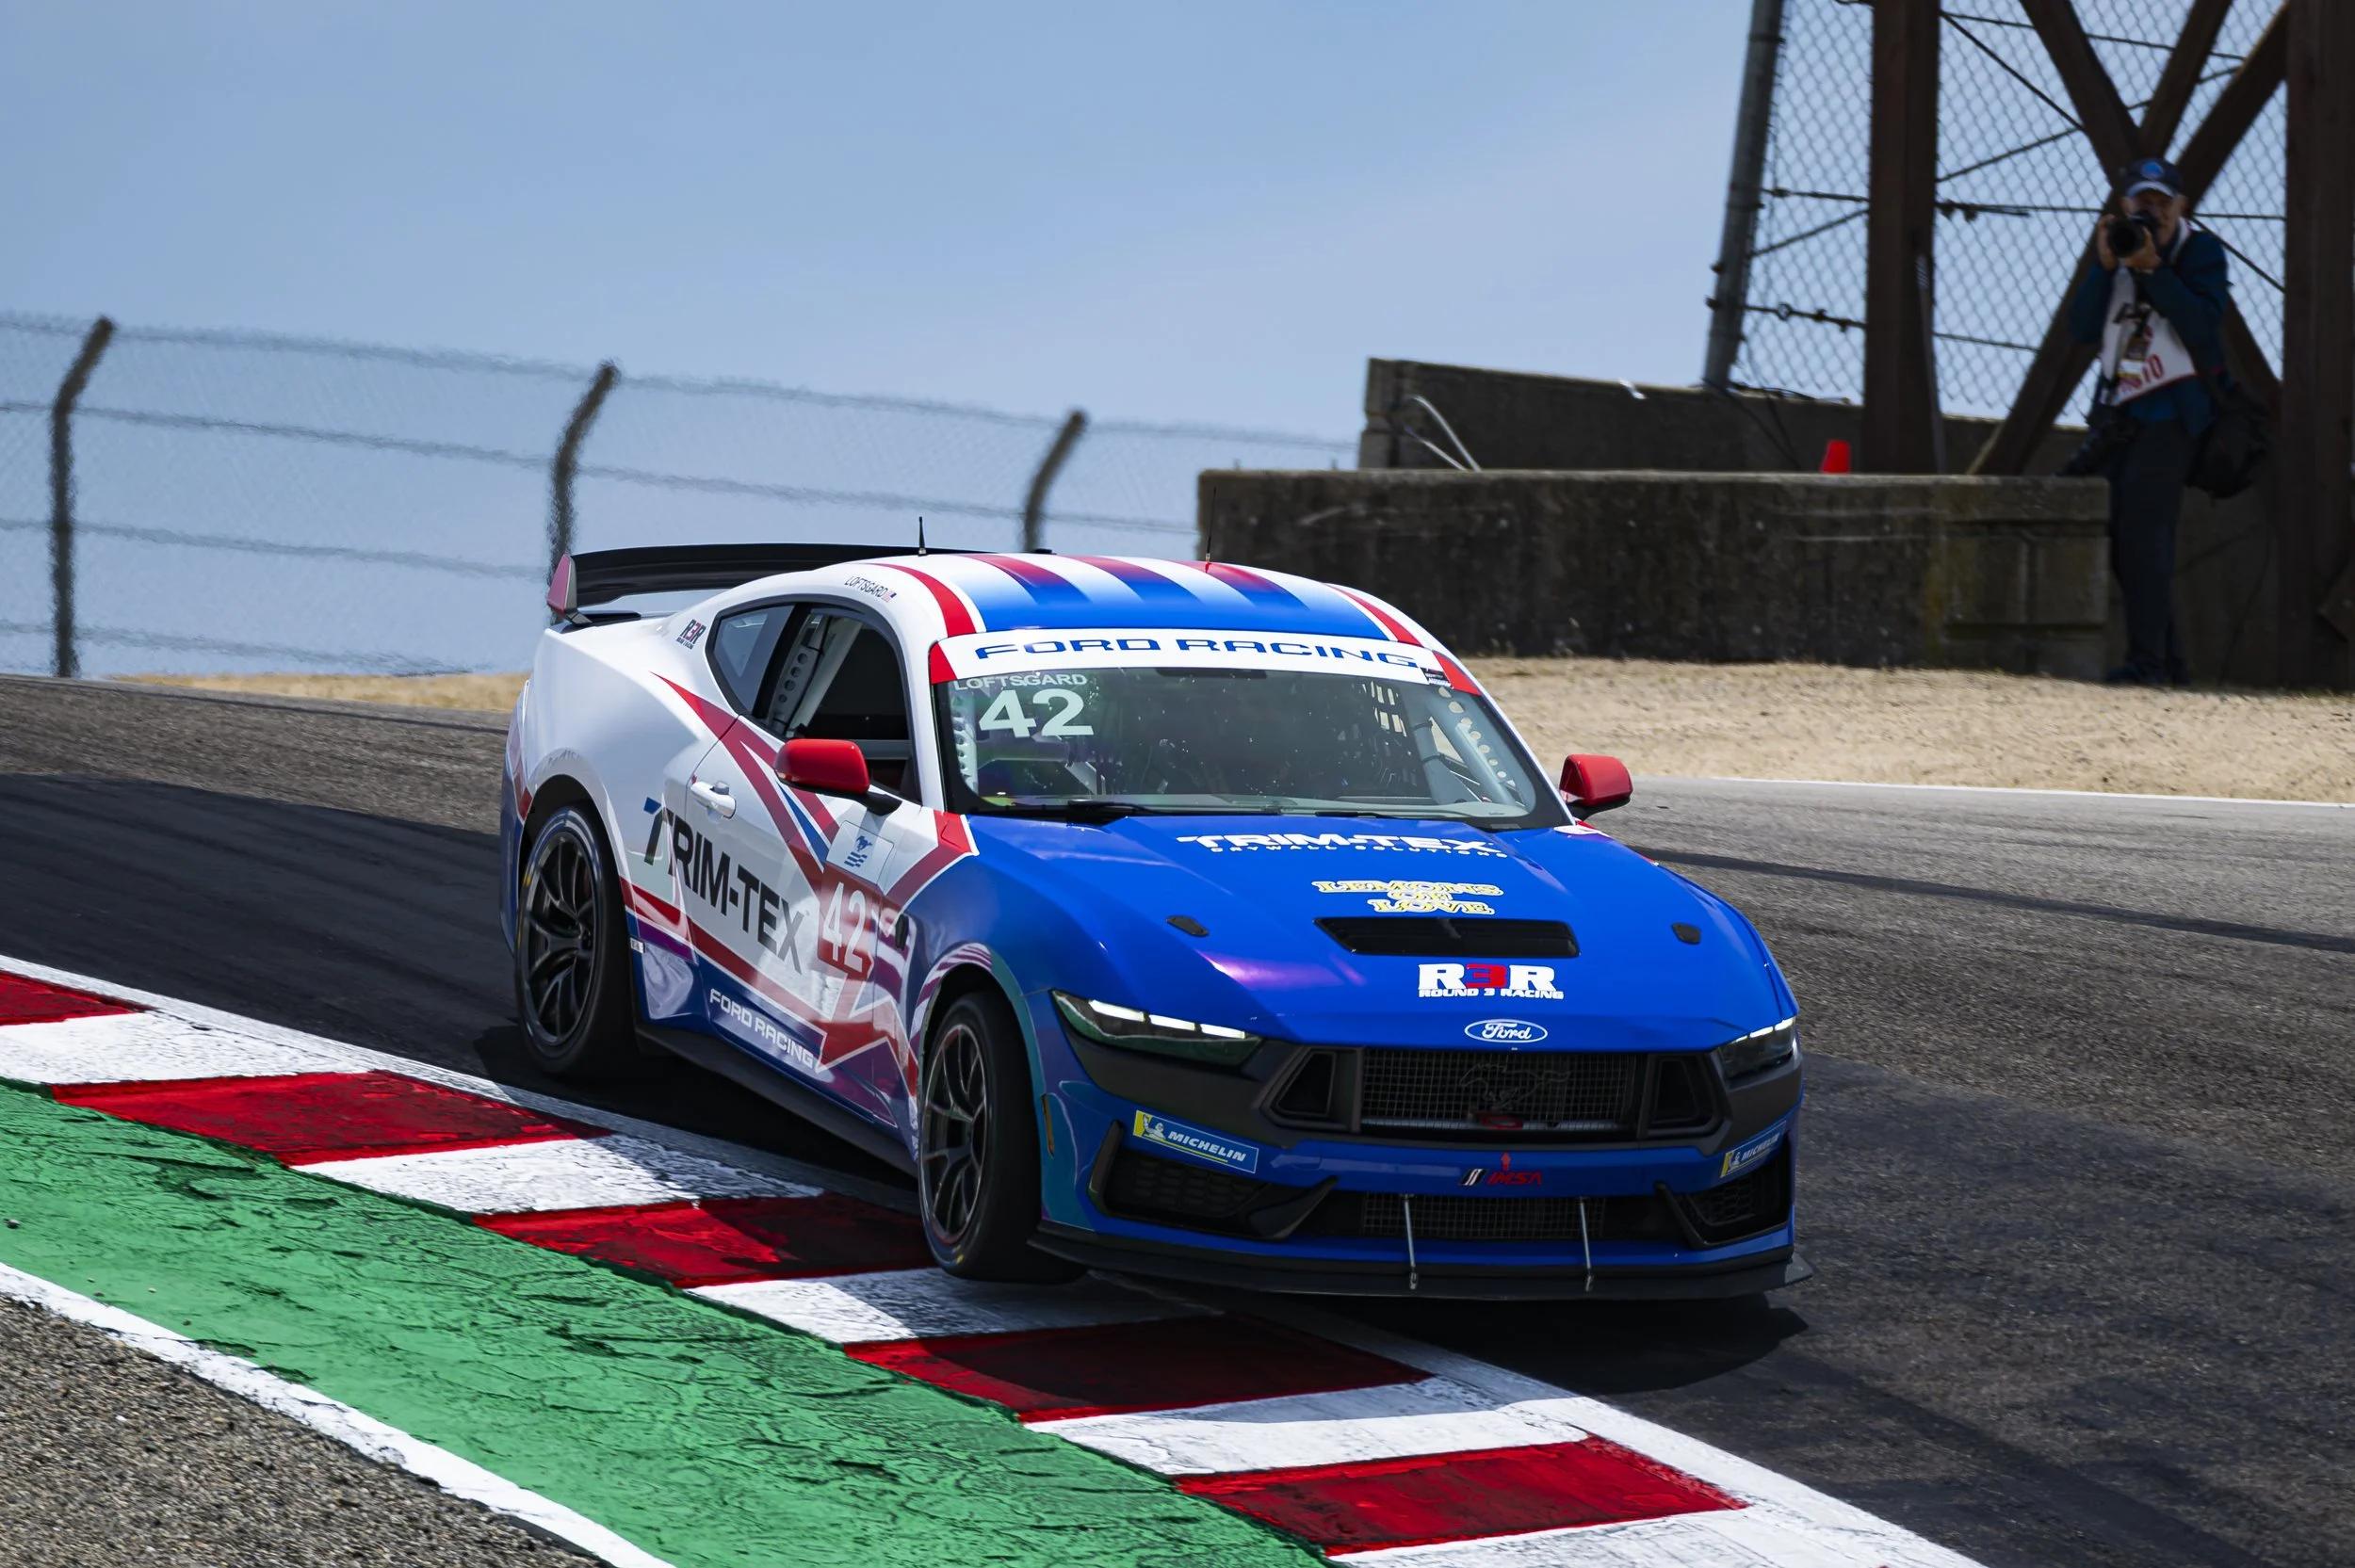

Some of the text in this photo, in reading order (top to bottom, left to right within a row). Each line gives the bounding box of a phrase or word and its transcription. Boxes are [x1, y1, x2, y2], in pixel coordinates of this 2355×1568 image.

[844, 575, 888, 597] LOFTSGARD
[680, 619, 706, 644] R3R
[975, 639, 1418, 668] FORD RACING
[953, 673, 1088, 690] LOFTSGARD
[979, 688, 1094, 738] 42
[1177, 833, 1502, 852] TRIM-TEX
[643, 797, 804, 975] TRIM-TEX
[1313, 881, 1503, 896] LEMONS
[1389, 892, 1453, 901] OF
[1370, 899, 1494, 914] LOVE
[822, 881, 866, 973] 42
[1418, 962, 1557, 992] R3R
[1419, 988, 1565, 1000] ROUND 3 RACING
[709, 988, 815, 1069] FORD RACING
[1481, 1022, 1533, 1041] Ford
[1168, 1130, 1246, 1162] MICHELIN
[1486, 1172, 1542, 1186] IMSA
